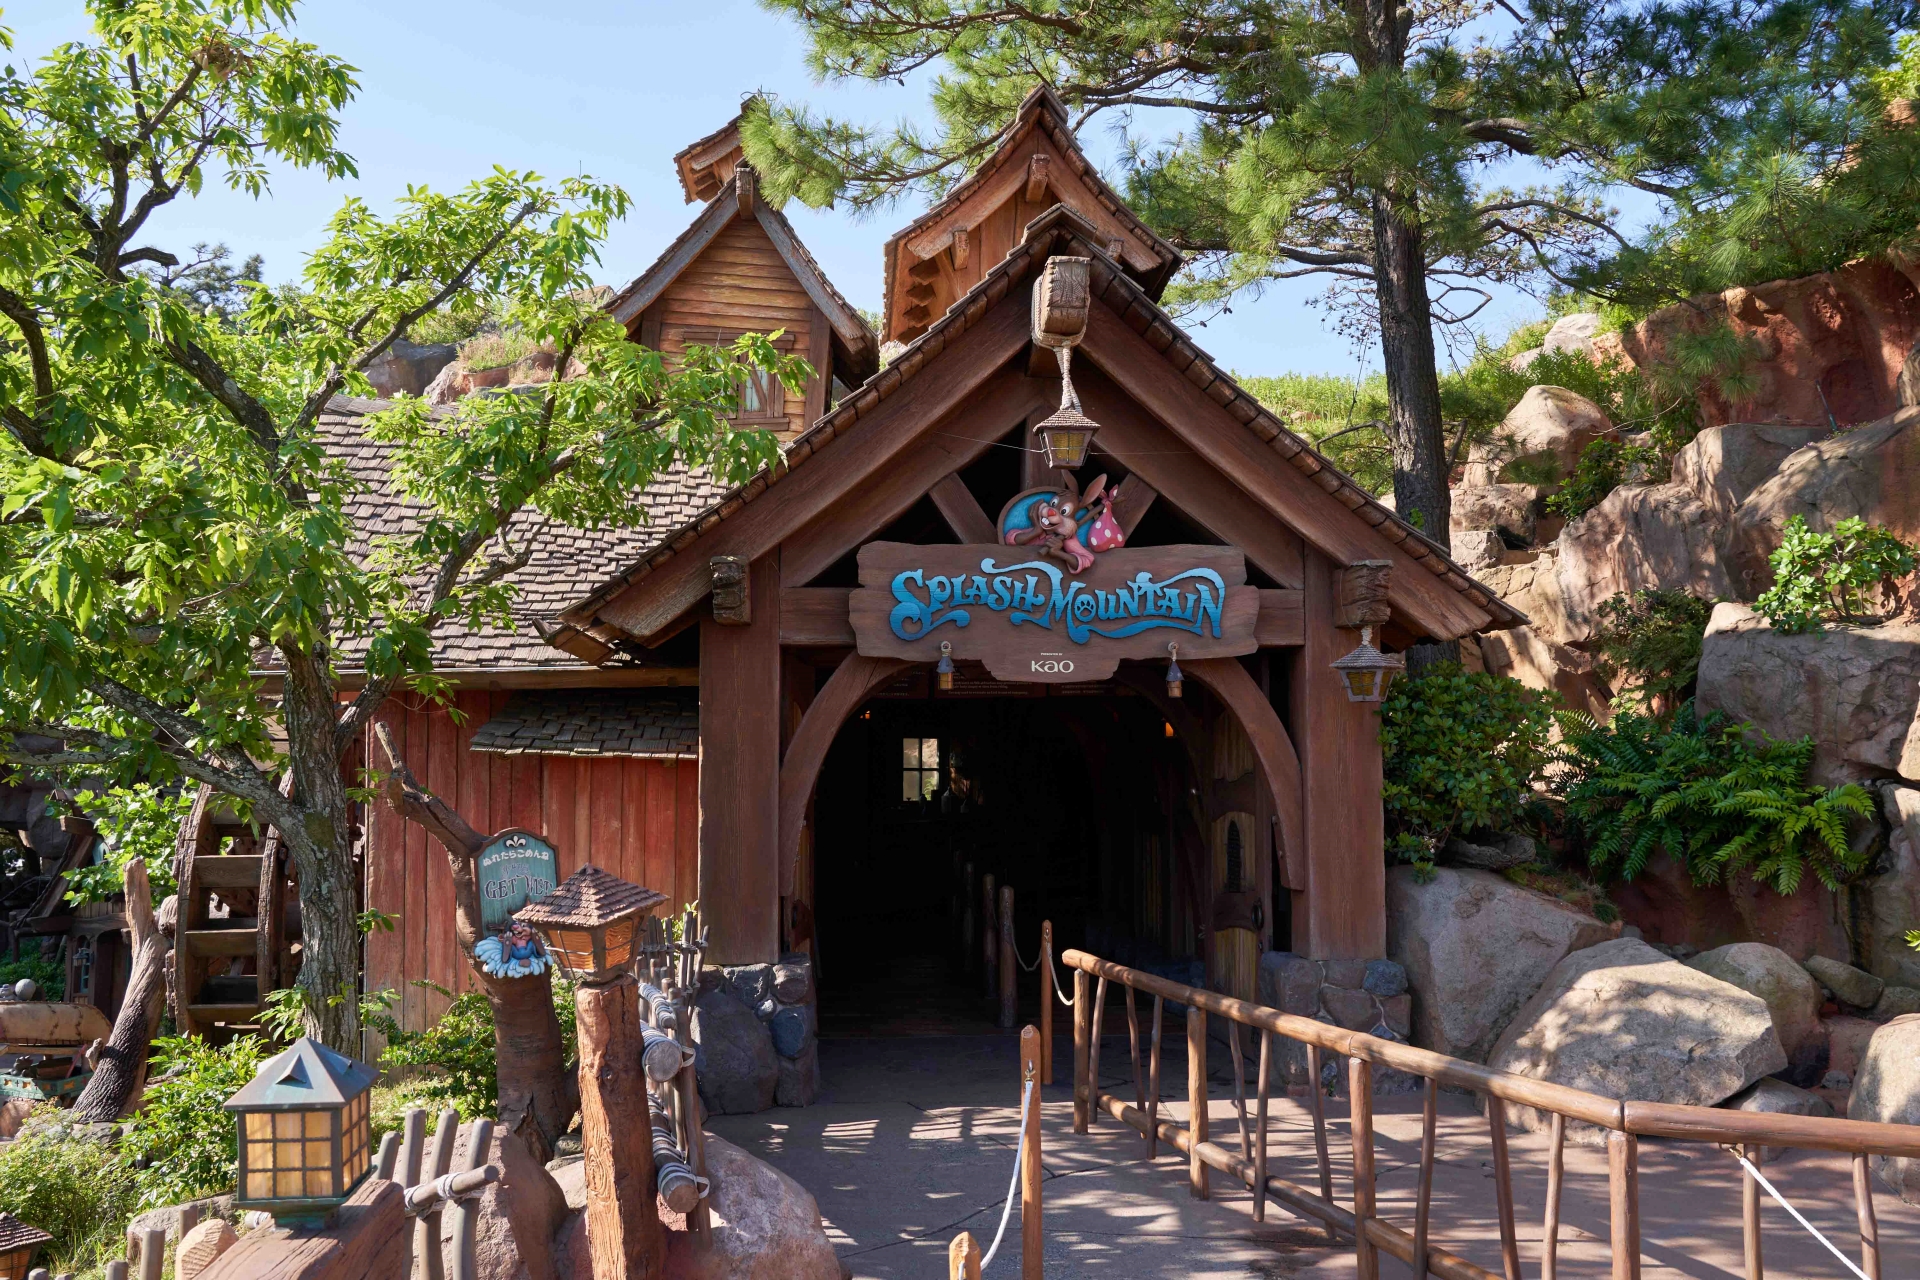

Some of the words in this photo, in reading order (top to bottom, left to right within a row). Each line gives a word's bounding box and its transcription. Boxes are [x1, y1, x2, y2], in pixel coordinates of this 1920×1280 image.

[889, 567, 1045, 641] SPLASH
[981, 557, 1226, 644] MOUNTAIN
[485, 878, 517, 900] GET
